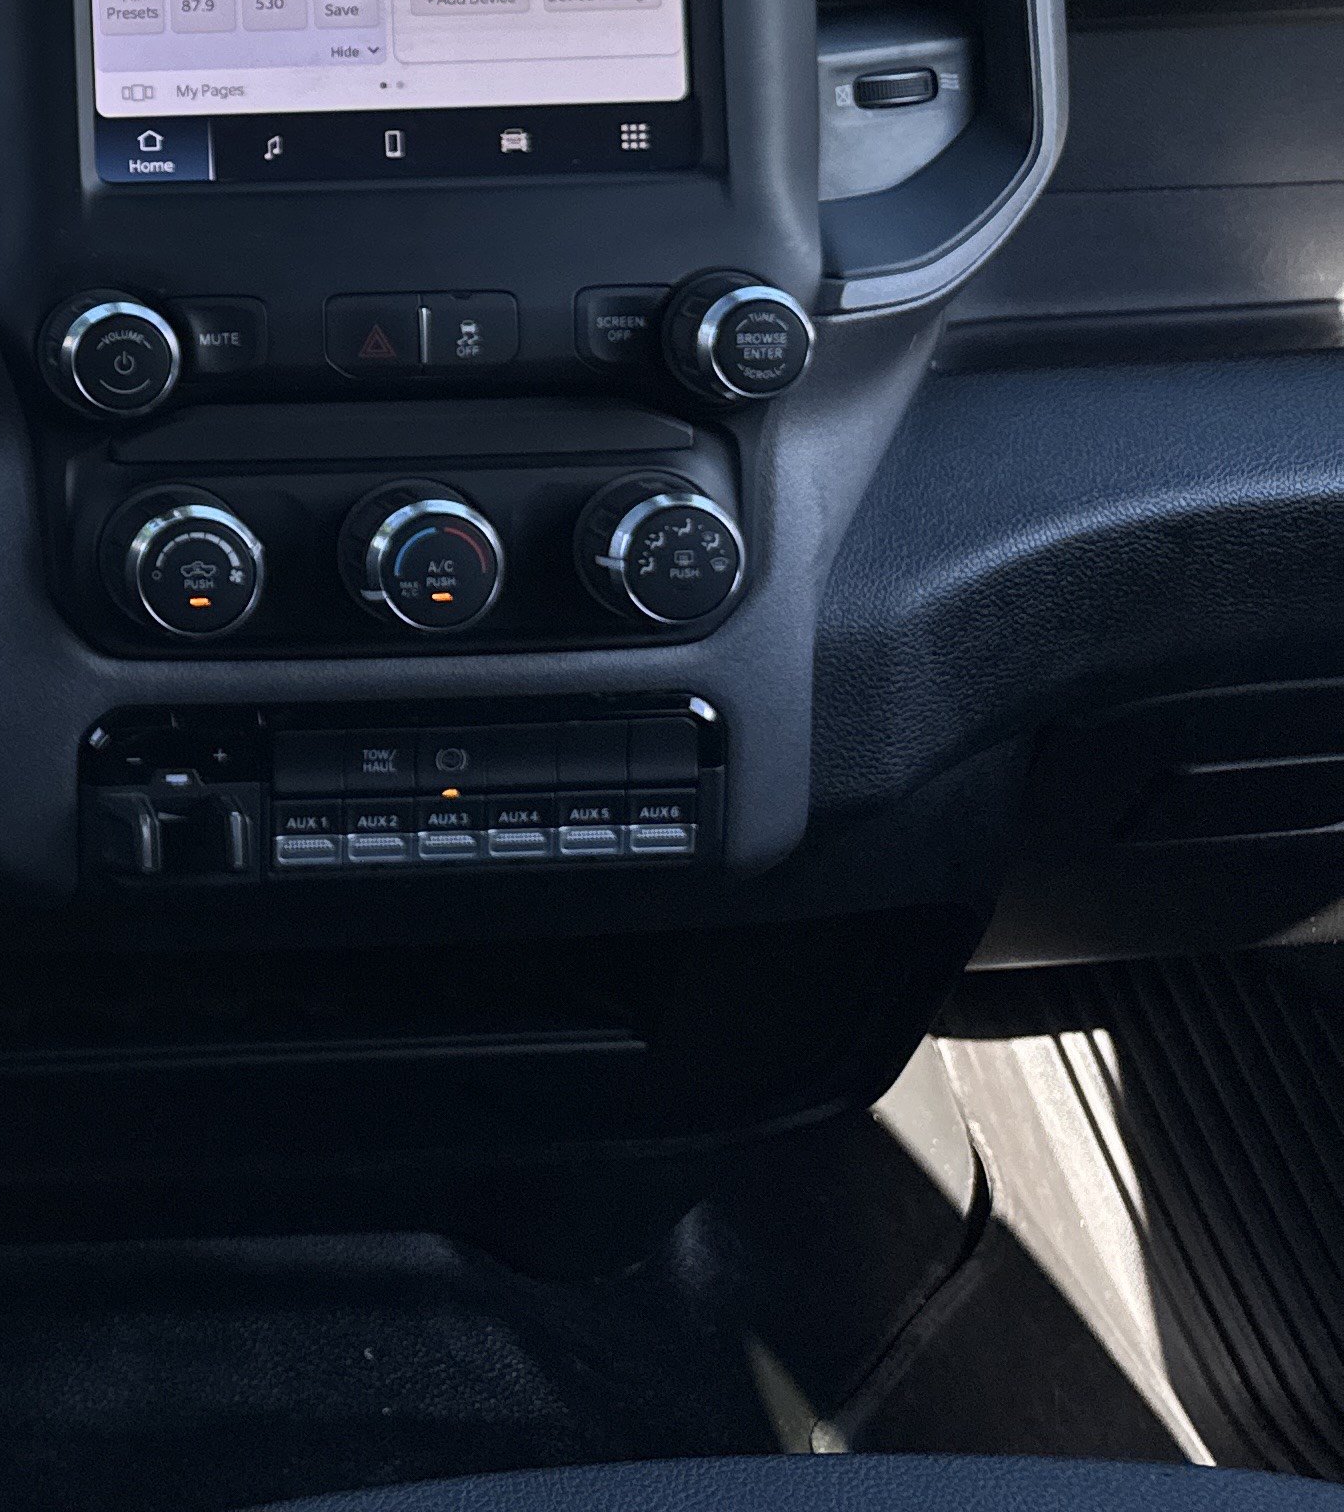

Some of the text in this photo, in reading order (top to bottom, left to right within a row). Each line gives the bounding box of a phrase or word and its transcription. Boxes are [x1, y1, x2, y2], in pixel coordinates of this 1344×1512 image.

[181, 0, 215, 13] 87.9
[325, 4, 359, 17] Save
[106, 7, 159, 21] Presets
[331, 46, 360, 59] Hide
[176, 84, 244, 100] My Pages
[129, 159, 175, 173] Home
[596, 315, 645, 329] SCREEN
[748, 312, 776, 324] TUNE
[101, 330, 144, 345] VOLUME
[199, 332, 240, 347] MUTE
[607, 329, 631, 342] OFF
[737, 332, 787, 345] BROWSE
[456, 345, 481, 357] OFF
[743, 346, 783, 360] ENTER
[743, 366, 785, 380] SCROLL
[428, 559, 455, 574] A/C
[669, 567, 700, 579] PUSH
[184, 578, 214, 590] PUSH
[426, 576, 456, 588] PUSH
[362, 760, 396, 773] HAUL
[429, 813, 468, 826] AUX 3
[499, 811, 539, 824] AUX 4
[570, 808, 610, 821] AUX 5
[640, 806, 679, 820] AUX 6
[287, 816, 327, 828] AUX 1
[357, 815, 398, 827] AUX 2
